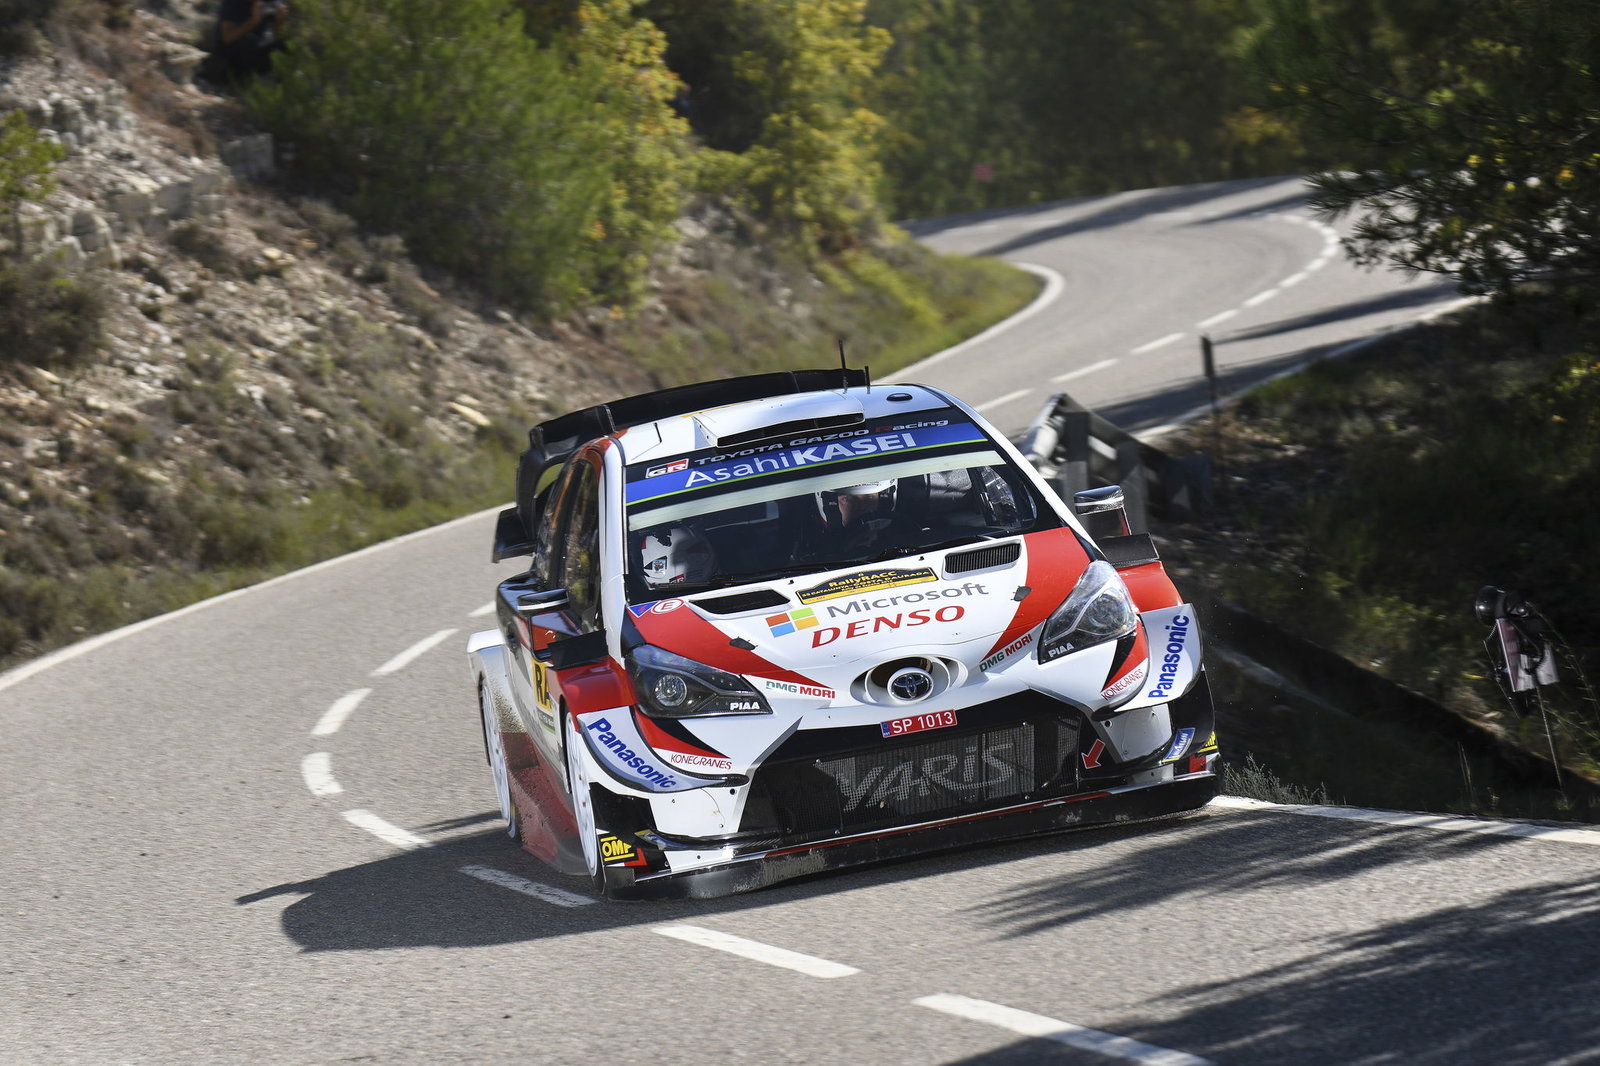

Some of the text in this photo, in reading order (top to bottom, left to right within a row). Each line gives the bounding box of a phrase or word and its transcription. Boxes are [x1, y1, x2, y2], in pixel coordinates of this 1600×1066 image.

[694, 419, 949, 465] TOYOTA GAZOO Racing
[648, 462, 687, 477] GR
[661, 601, 675, 611] E
[826, 583, 990, 618] Microsoft
[811, 605, 965, 648] DENSO
[978, 633, 1033, 673] DMG MORI
[1047, 642, 1075, 658] PIAA
[1148, 615, 1190, 698] Panasonic
[766, 681, 836, 699] DMG MORI
[1100, 668, 1144, 700] KONECRANES
[729, 701, 761, 711] PIAA
[892, 711, 954, 734] SP 1013
[587, 717, 677, 788] Panasonic
[670, 753, 733, 770] KONECRANES
[602, 839, 632, 857] OMP
